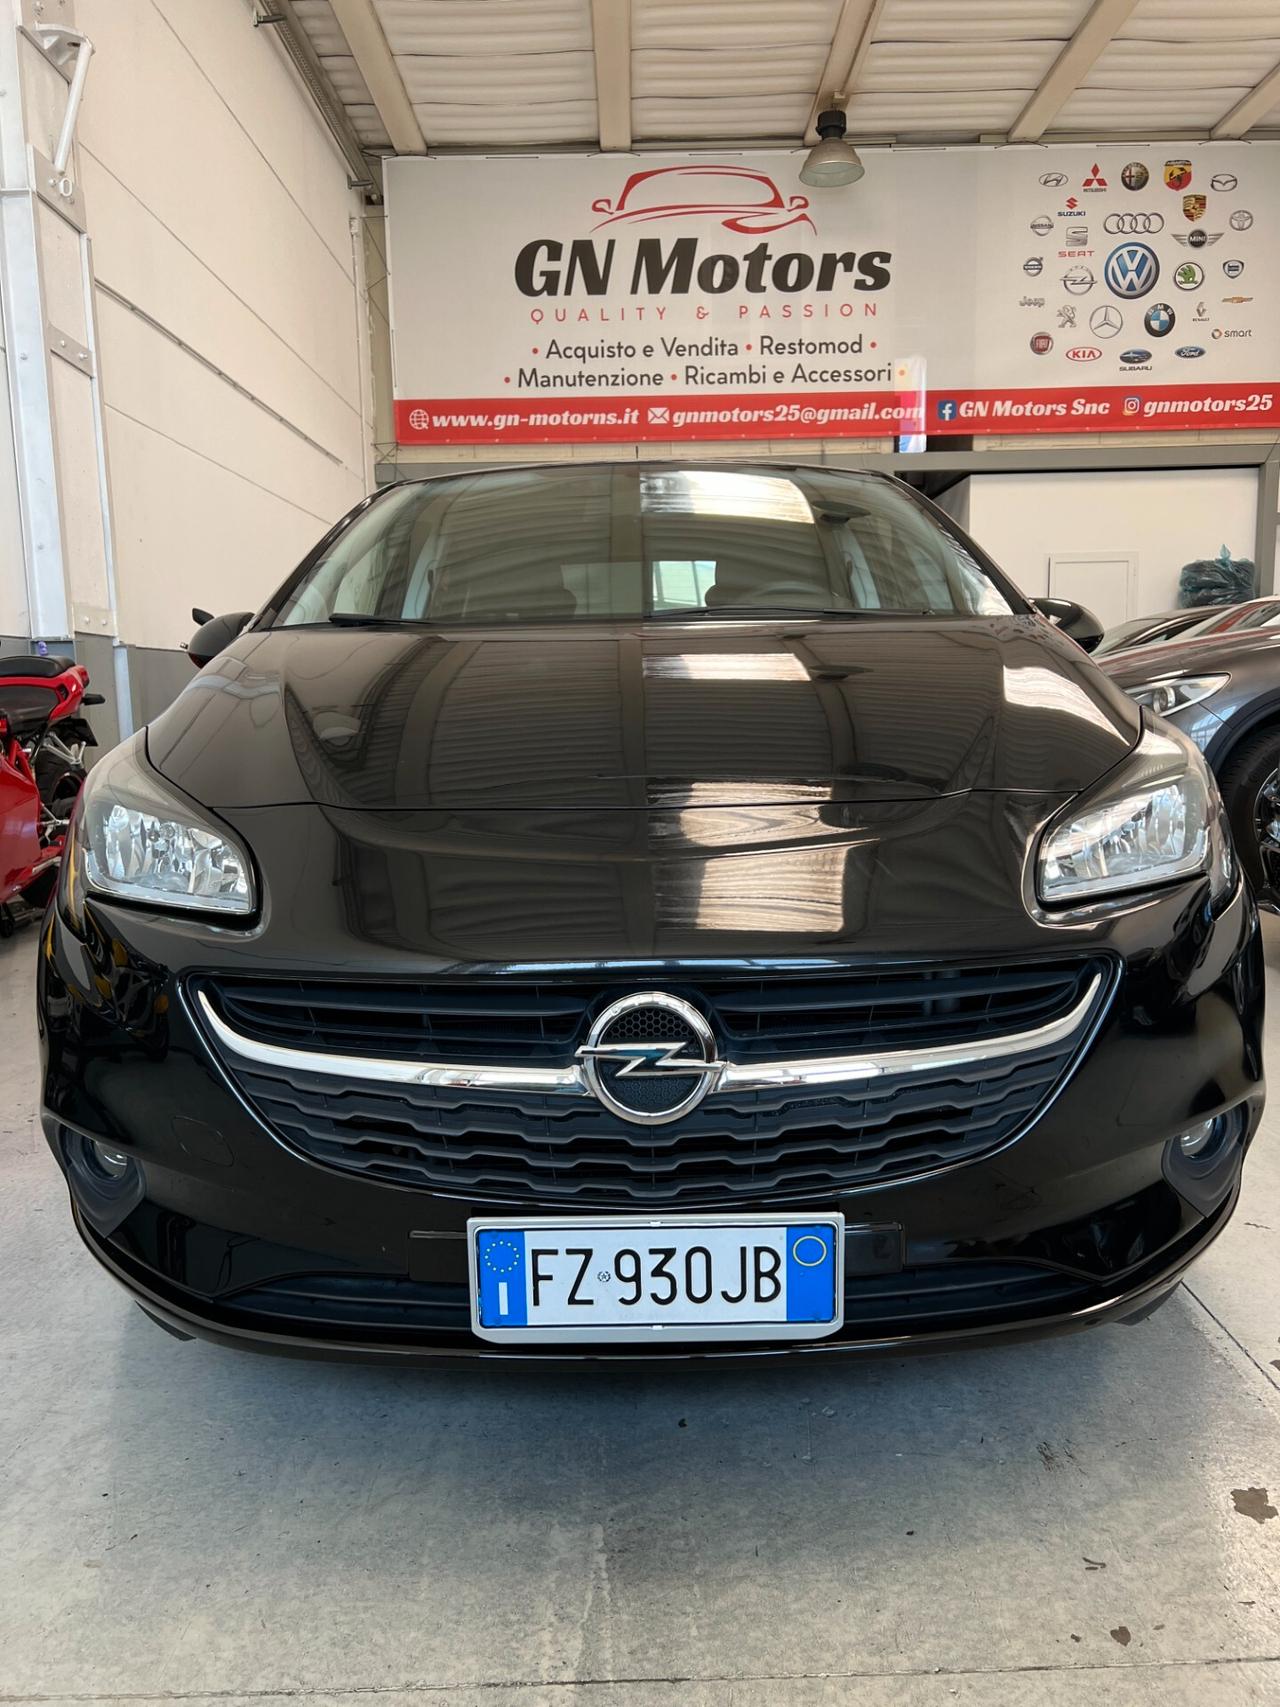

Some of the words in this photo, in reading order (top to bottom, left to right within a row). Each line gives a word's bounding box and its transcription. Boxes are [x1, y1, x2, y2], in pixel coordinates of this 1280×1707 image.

[1058, 250, 1095, 258] SEAT
[514, 239, 616, 297] GN
[630, 237, 893, 295] Motors
[530, 306, 667, 325] QUALITY
[696, 306, 710, 320] &
[738, 303, 877, 320] PASSION
[1224, 329, 1252, 338] smart
[545, 338, 637, 363] Acquisto
[642, 343, 655, 358] e
[660, 337, 739, 358] Vendita
[760, 334, 863, 356] Restomod
[1071, 350, 1097, 359] KIA
[517, 367, 664, 388] Manutenzione
[684, 364, 767, 385] Ricambi
[772, 369, 785, 384] e
[791, 362, 893, 384] Accessori
[672, 402, 923, 428] gnmotors25@gmail.com
[959, 400, 989, 418] GN
[992, 400, 1067, 418] Motors
[1071, 398, 1110, 416] Snc
[1143, 394, 1273, 417] gnmotors25
[431, 407, 640, 430] www.gn-motorns.it
